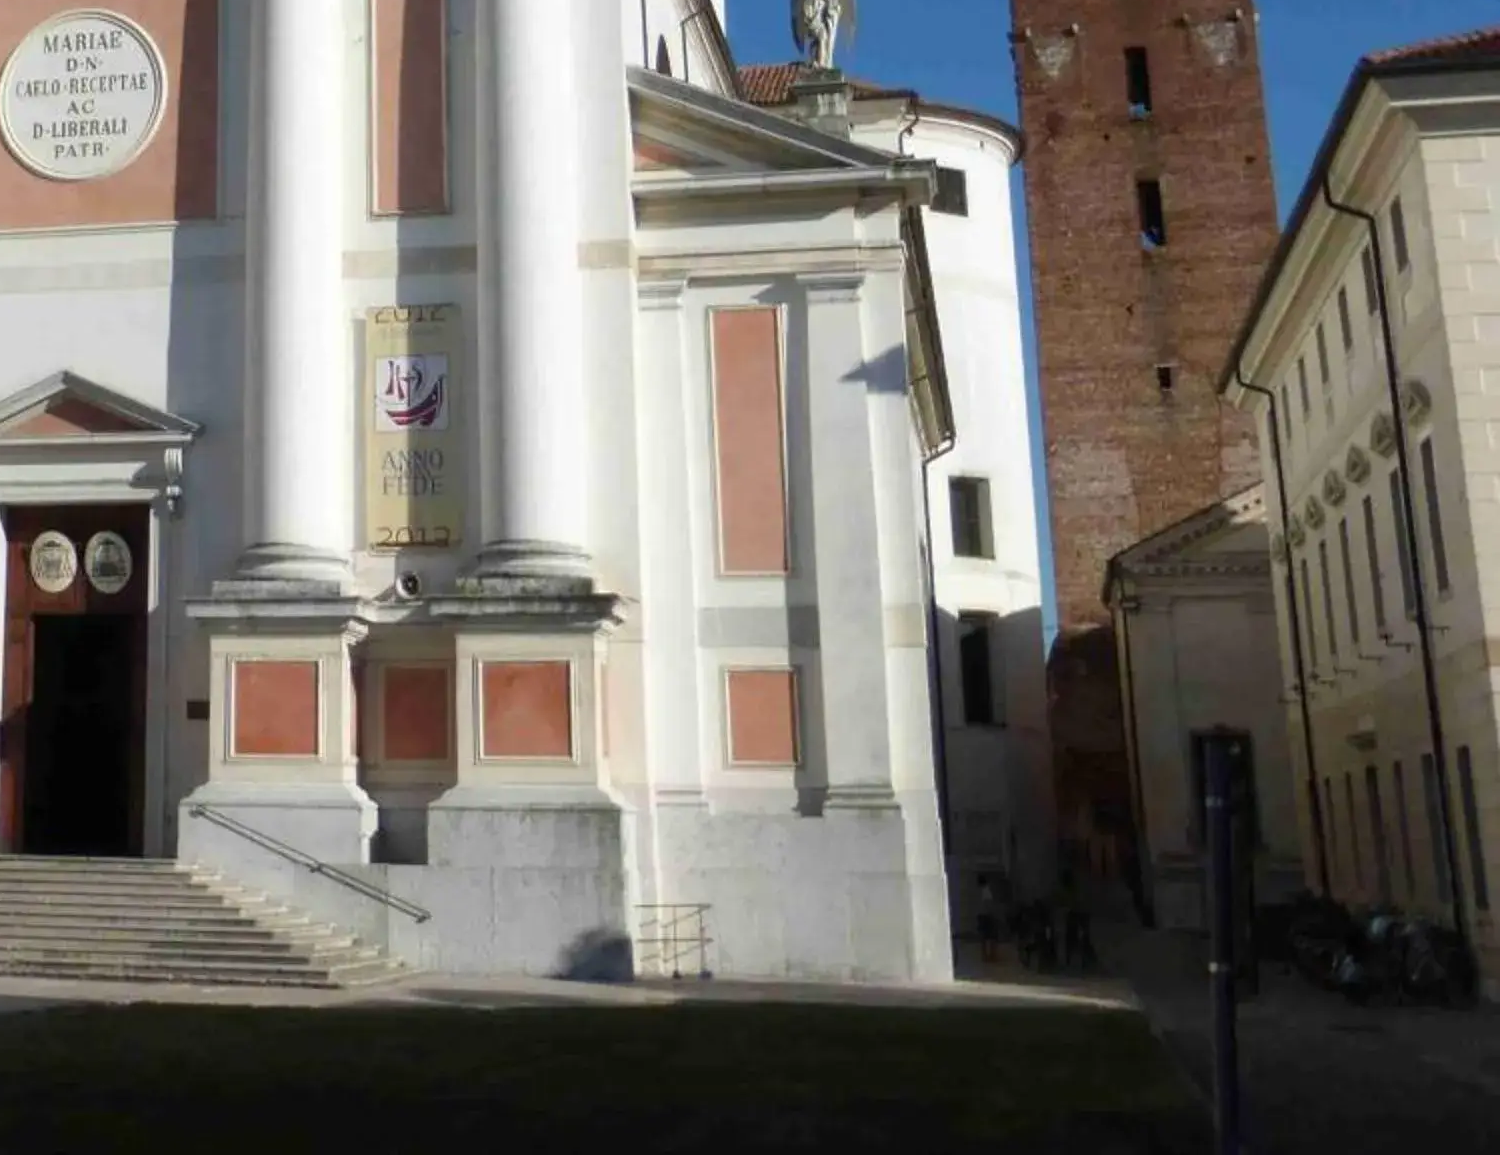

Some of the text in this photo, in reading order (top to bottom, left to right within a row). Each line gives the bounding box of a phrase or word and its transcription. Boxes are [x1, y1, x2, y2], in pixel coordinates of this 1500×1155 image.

[43, 30, 122, 54] MARIAE
[67, 100, 95, 115] AC
[375, 304, 446, 324] 2012
[381, 448, 445, 473] ANNO
[376, 526, 451, 547] 2013
